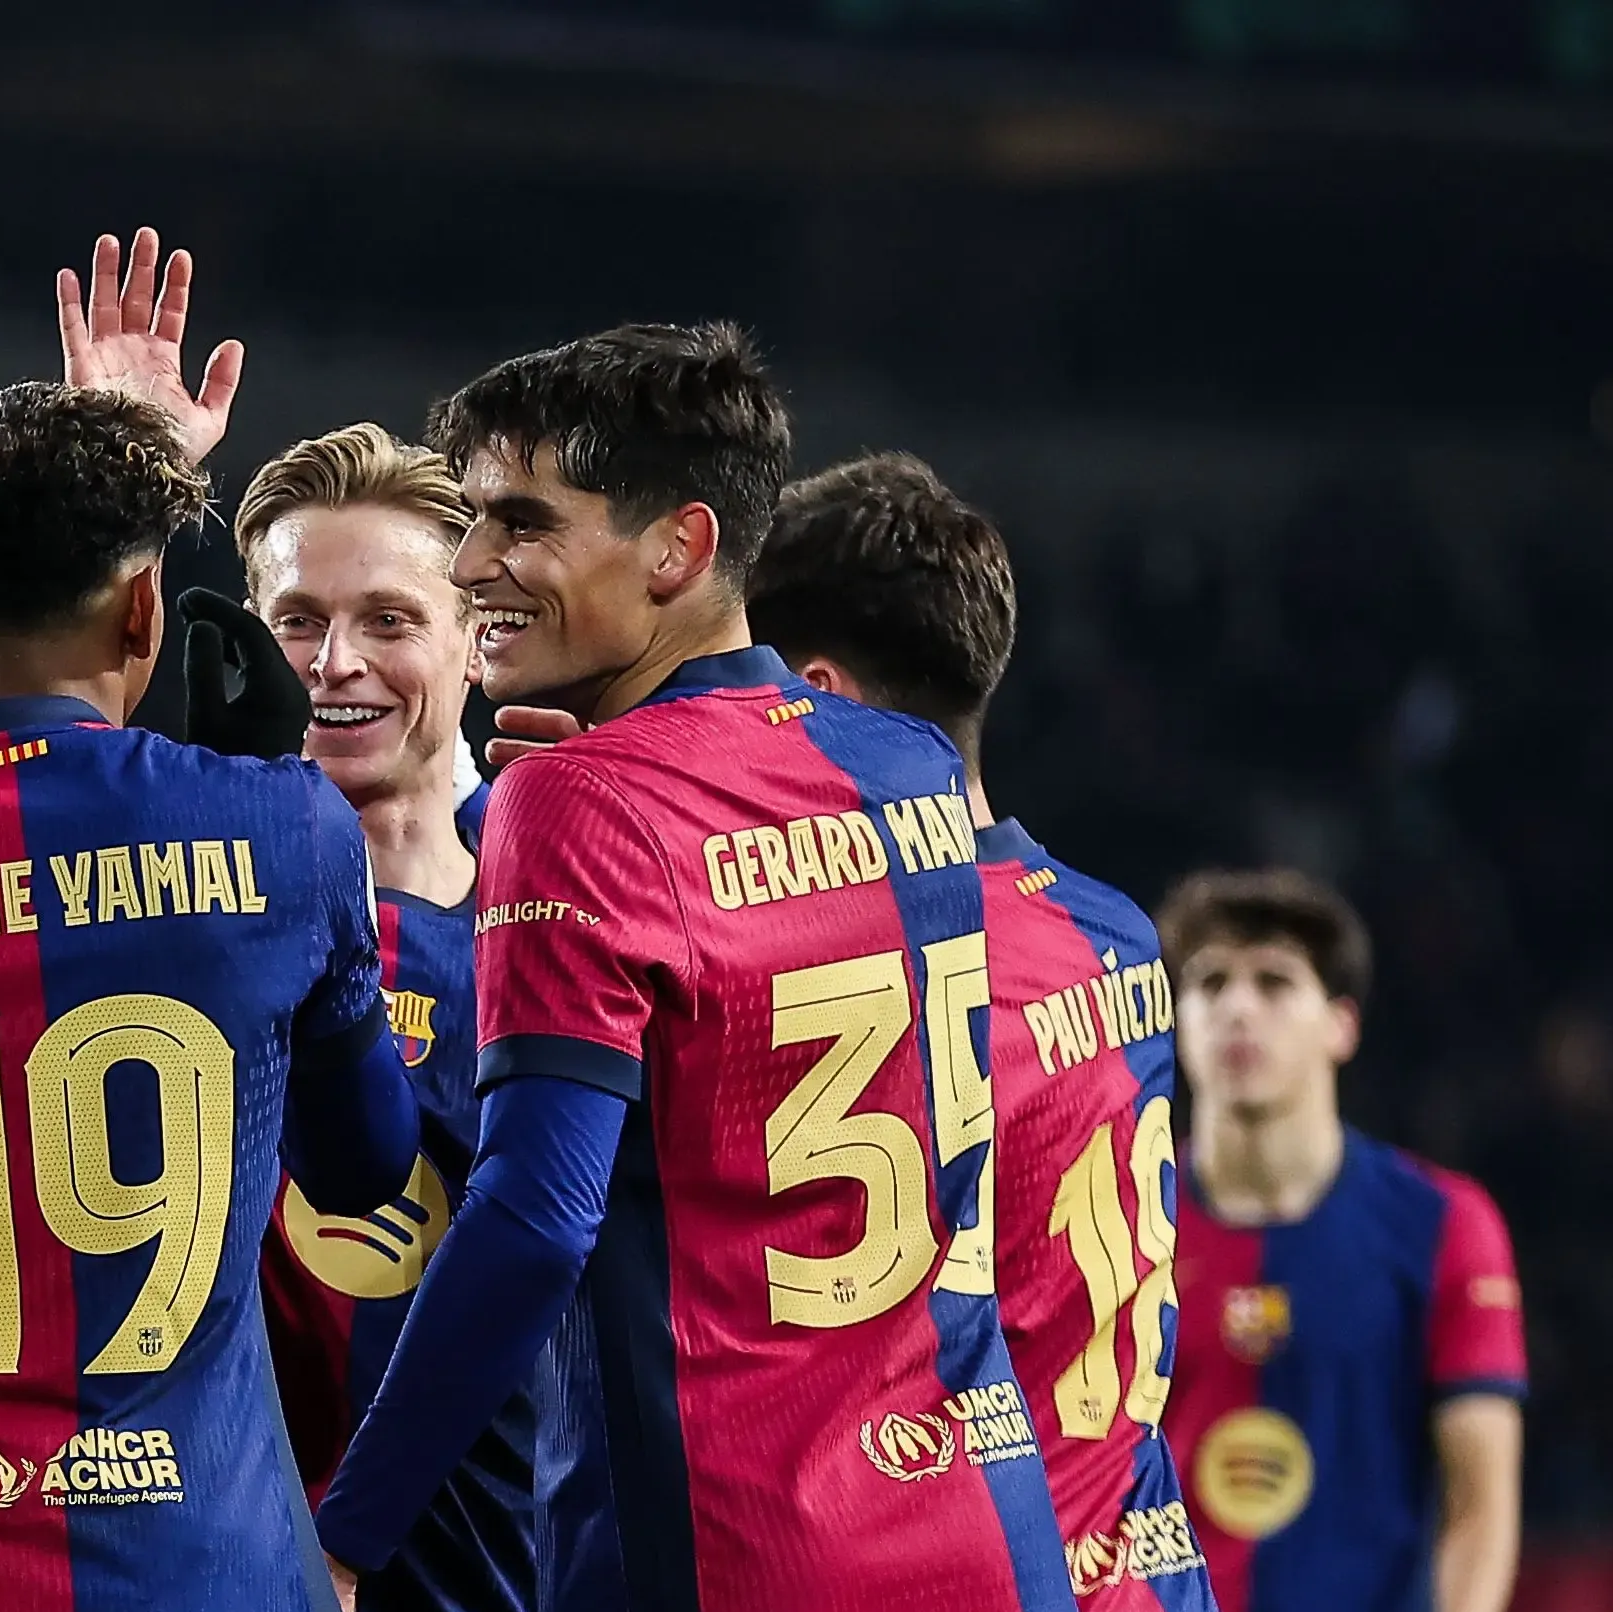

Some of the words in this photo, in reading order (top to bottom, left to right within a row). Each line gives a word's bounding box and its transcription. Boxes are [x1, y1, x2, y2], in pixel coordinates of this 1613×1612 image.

[49, 839, 267, 927] YAMAL
[702, 810, 889, 911] GERARD
[1022, 982, 1099, 1077] PAU
[1089, 946, 1175, 1051] VÍCTO
[764, 930, 996, 1329] 35
[1048, 1095, 1179, 1441] 18
[40, 1459, 182, 1492] ACNUR
[963, 1411, 1034, 1454] ACNUR
[42, 1495, 66, 1506] The
[68, 1494, 87, 1505] UN
[90, 1493, 139, 1505] Refugee
[141, 1490, 184, 1503] Agency
